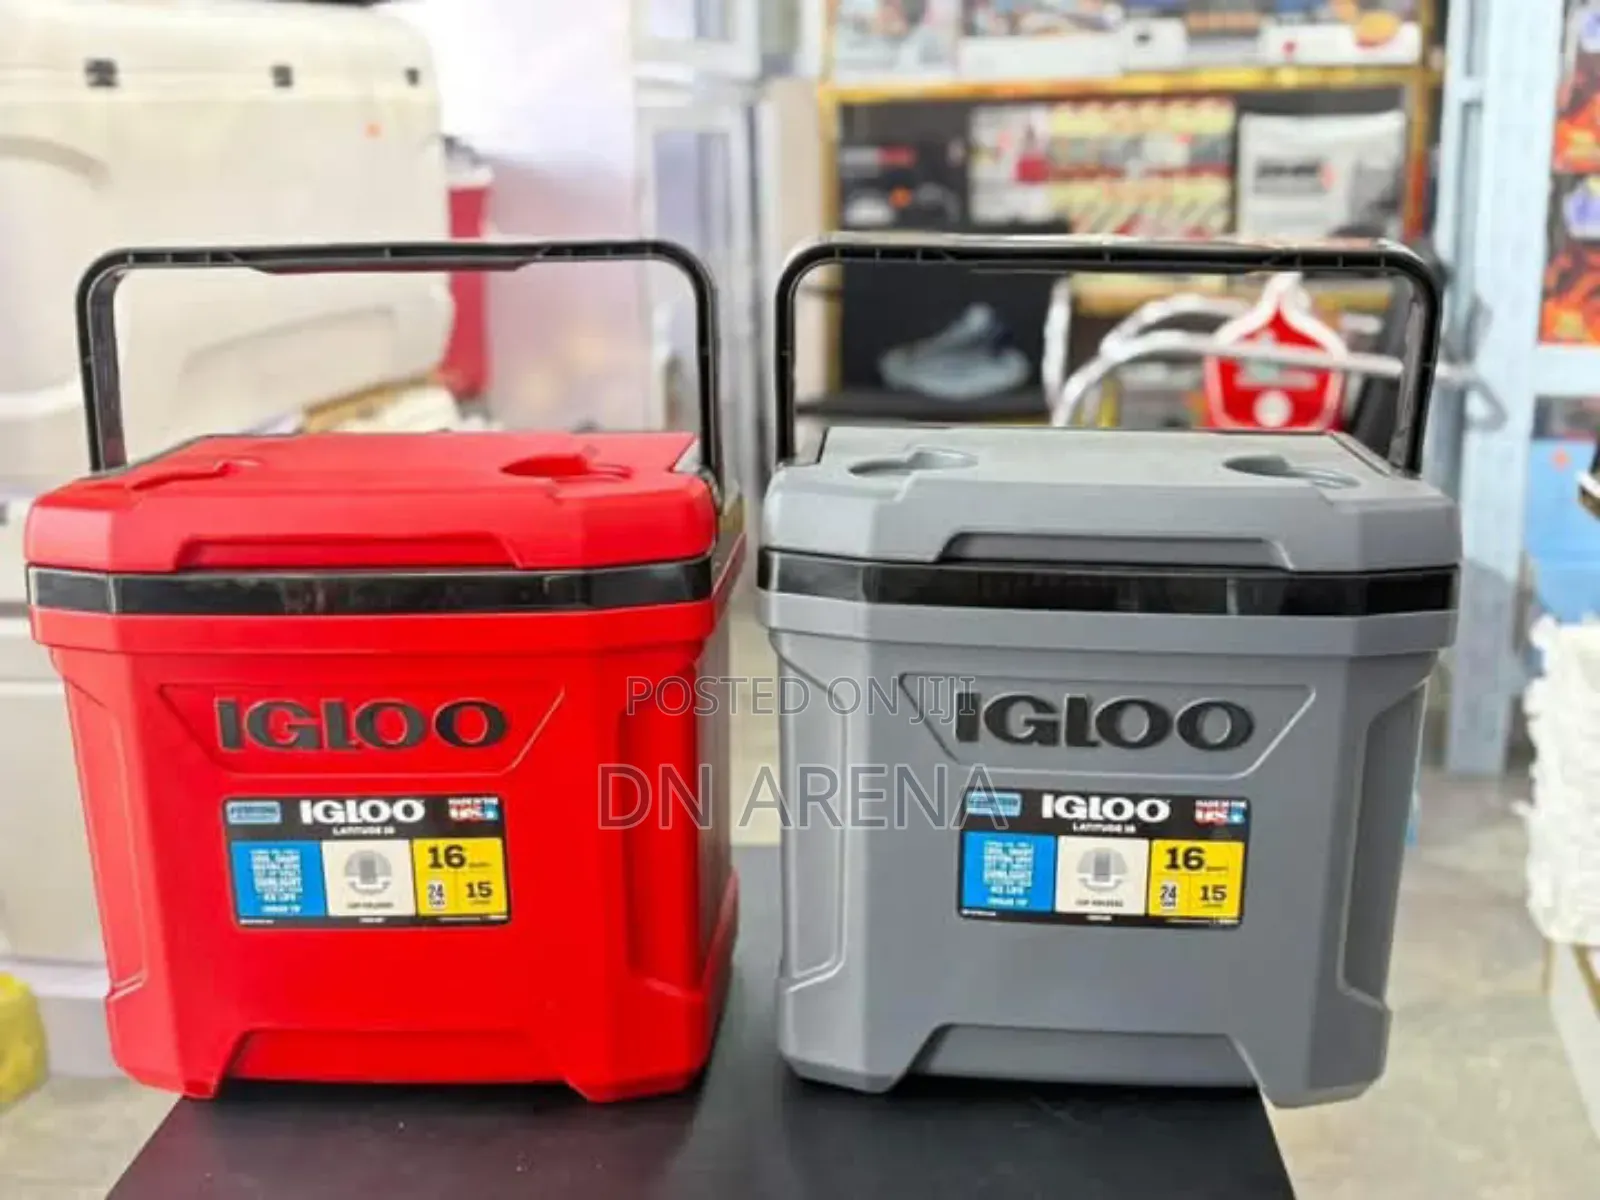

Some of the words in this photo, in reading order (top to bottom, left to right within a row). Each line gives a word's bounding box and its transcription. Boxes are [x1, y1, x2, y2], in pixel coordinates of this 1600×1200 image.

[213, 697, 510, 753] IGLOO
[954, 690, 1256, 751] IGLOO
[299, 799, 426, 825] IGLOO
[1041, 792, 1171, 823] IGLOO
[428, 844, 468, 870] 16
[1164, 845, 1206, 872] 16
[465, 881, 493, 899] 15
[1199, 884, 1227, 902] 15
